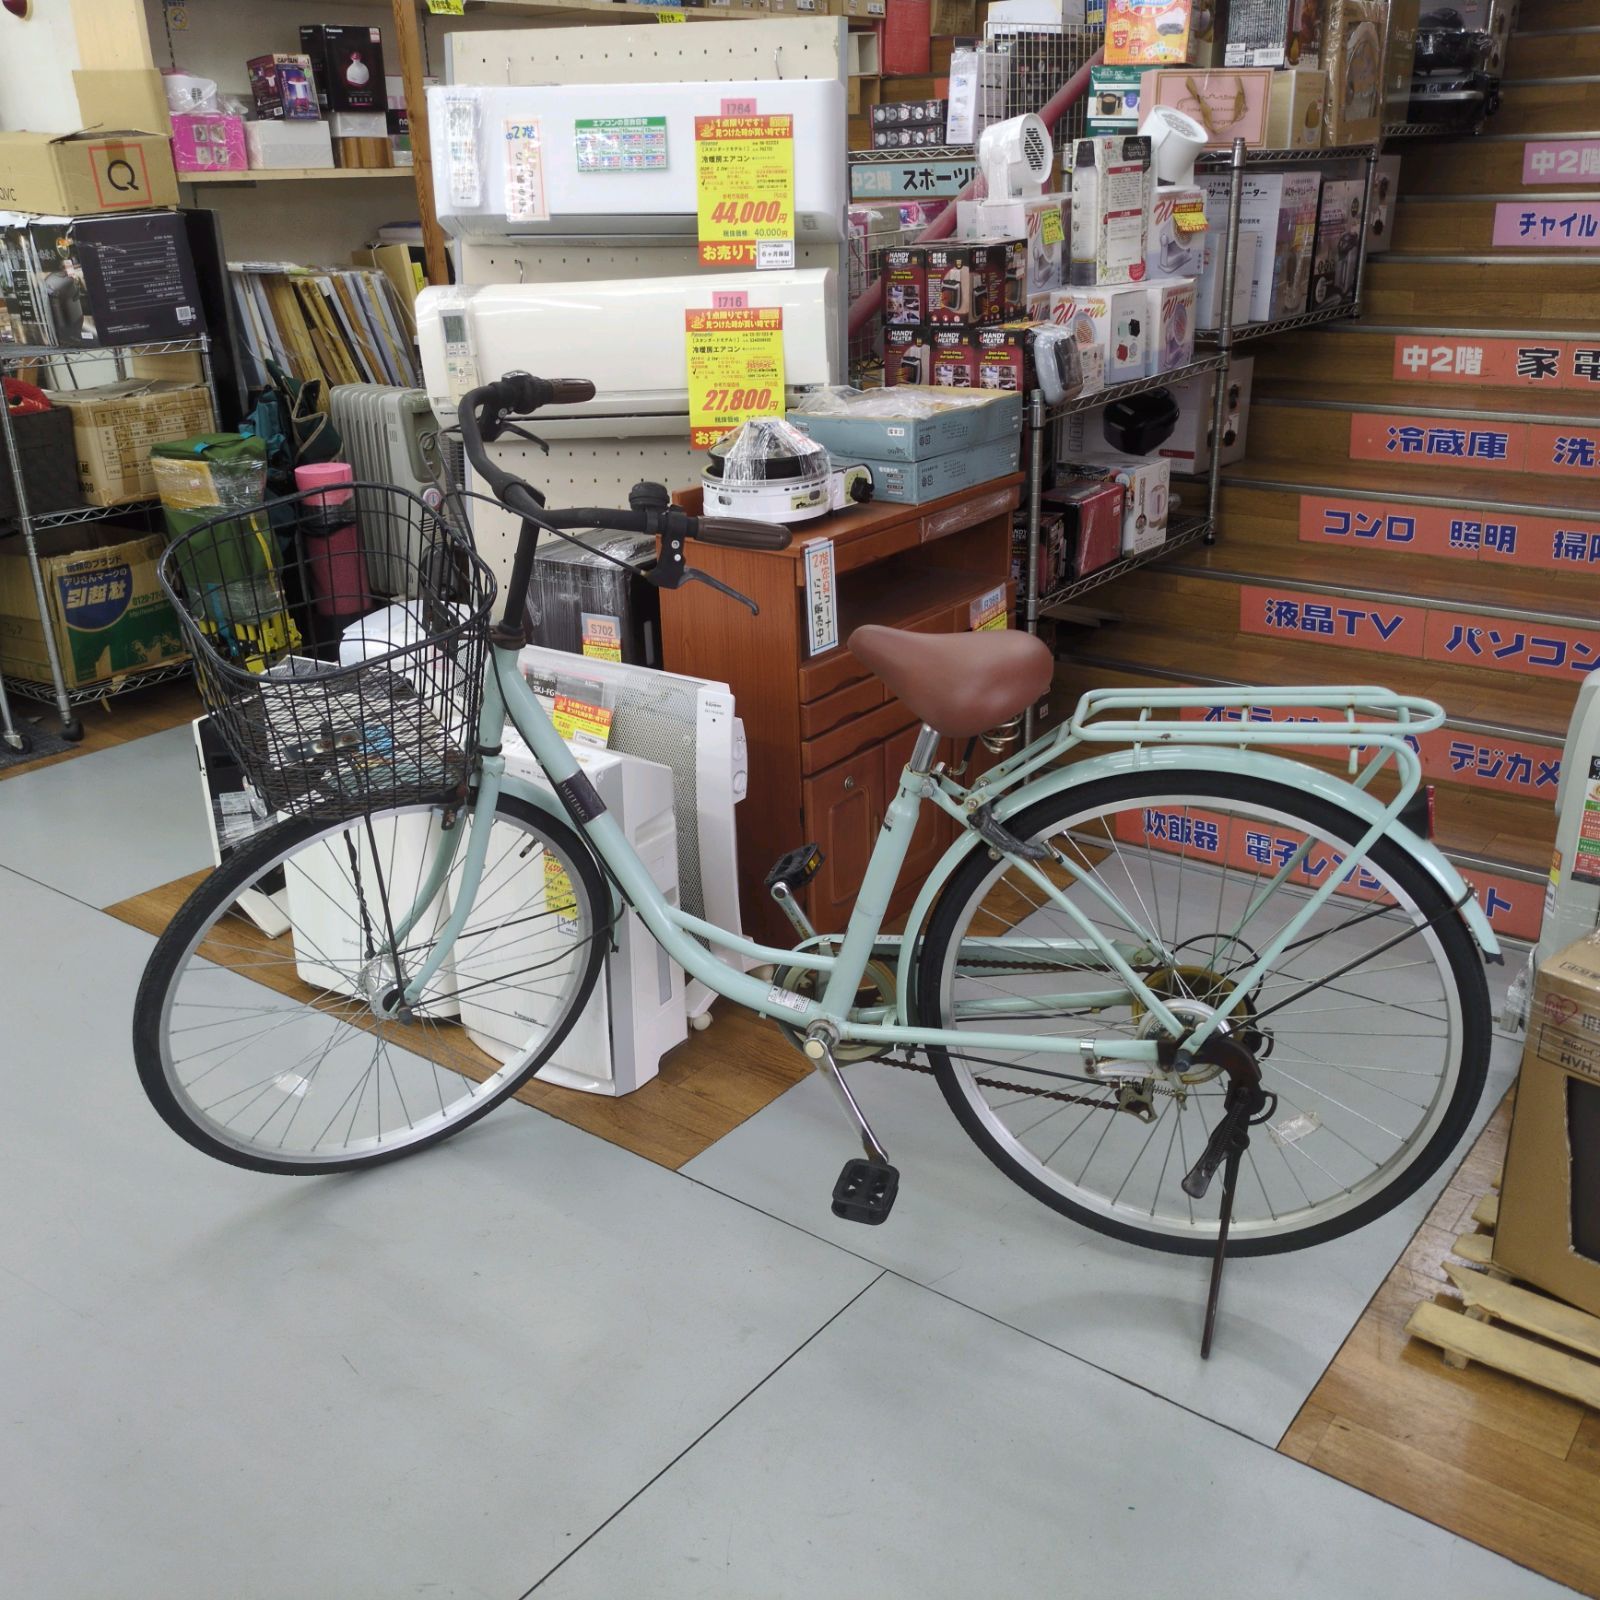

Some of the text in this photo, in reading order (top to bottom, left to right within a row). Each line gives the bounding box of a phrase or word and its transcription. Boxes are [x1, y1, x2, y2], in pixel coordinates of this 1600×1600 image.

[702, 155, 750, 164] 冷暖房エアコン
[1531, 147, 1600, 176] 中2階
[107, 158, 140, 191] Q
[851, 169, 892, 192] 中2階
[711, 200, 788, 226] 44,000円
[754, 228, 788, 238] 40,000円
[718, 296, 743, 308] 1716
[891, 330, 914, 338] HANDY
[938, 332, 961, 340] HANDY
[982, 332, 1006, 340] HANDY
[982, 337, 1006, 345] HEATER
[692, 345, 741, 354] 冷暖房エアコン
[1402, 344, 1600, 382] 中2階 家電
[702, 387, 779, 413] 27,800円
[695, 430, 730, 445] お売
[1386, 425, 1600, 468] 冷蔵庫 洗
[1323, 509, 1417, 544] コンロ
[1448, 519, 1518, 555] 照明
[66, 579, 128, 610] 引越社
[591, 623, 614, 637] S702
[1264, 597, 1600, 674] 液晶TV パソコン
[1448, 740, 1562, 790] デジカメ
[1143, 808, 1219, 853] 炊飯器
[1560, 1051, 1600, 1076] HVH-
